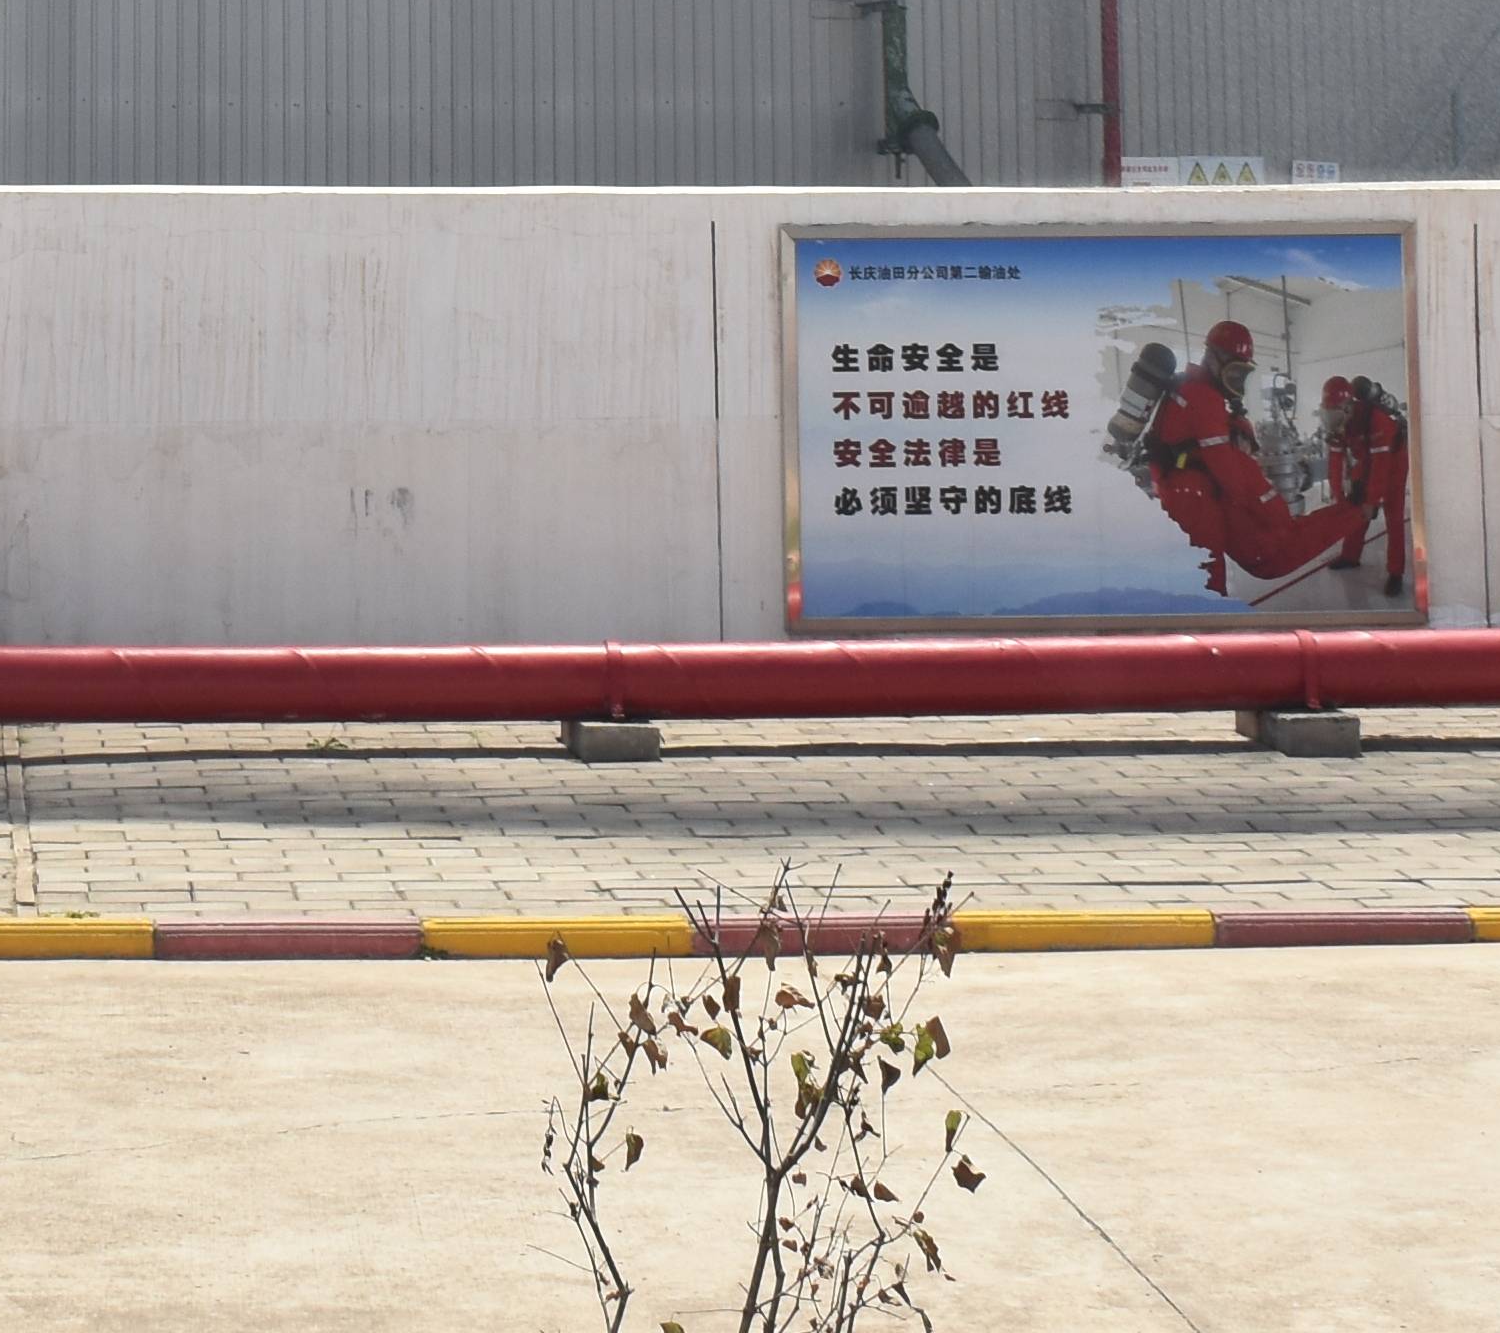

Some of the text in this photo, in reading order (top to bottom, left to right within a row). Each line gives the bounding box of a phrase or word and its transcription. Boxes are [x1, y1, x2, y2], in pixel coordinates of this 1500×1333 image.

[848, 264, 1021, 281] 长庆油田分公司第二输油处
[831, 342, 1000, 373] 生命安全是
[832, 389, 1070, 421] 不可逾越的红线
[833, 437, 1002, 469] 安全法律是
[834, 484, 1073, 517] 必须坚守的底线
